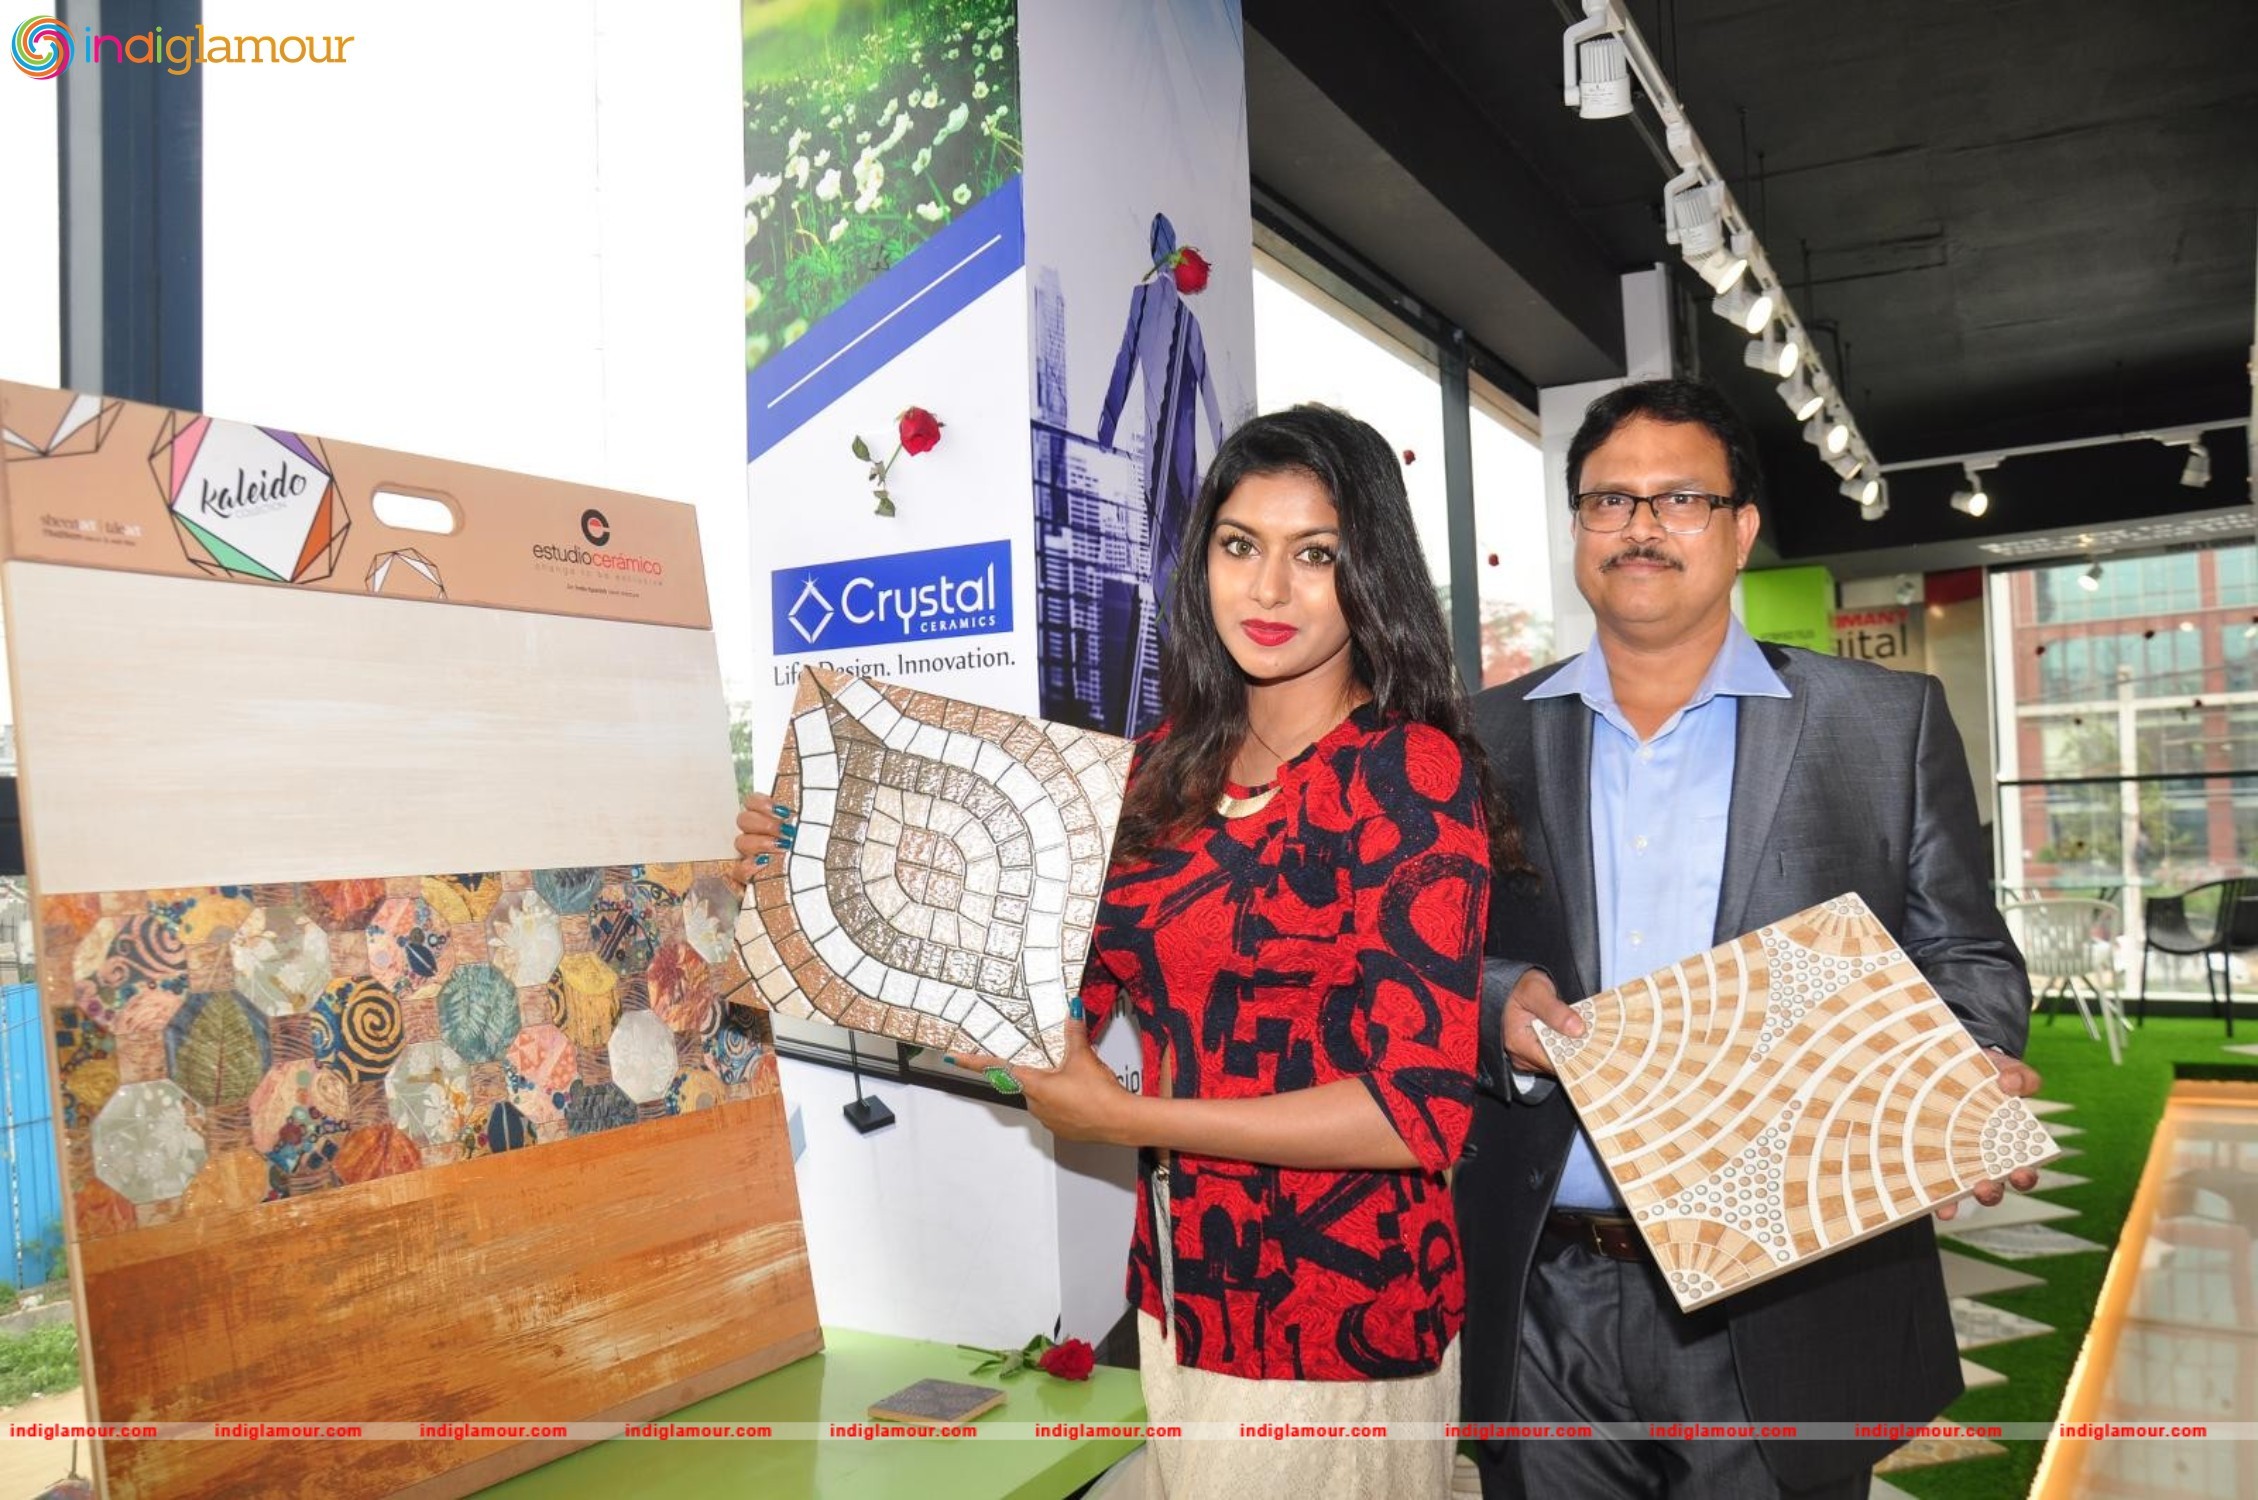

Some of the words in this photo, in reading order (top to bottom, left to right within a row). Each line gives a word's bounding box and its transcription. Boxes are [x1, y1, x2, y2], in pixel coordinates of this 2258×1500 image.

[201, 460, 307, 519] kaleido
[841, 561, 996, 635] Crystal
[920, 615, 997, 633] CERAMICS
[1836, 623, 1907, 660] ital
[774, 661, 803, 686] Lif
[898, 647, 1016, 676] Innovation.
